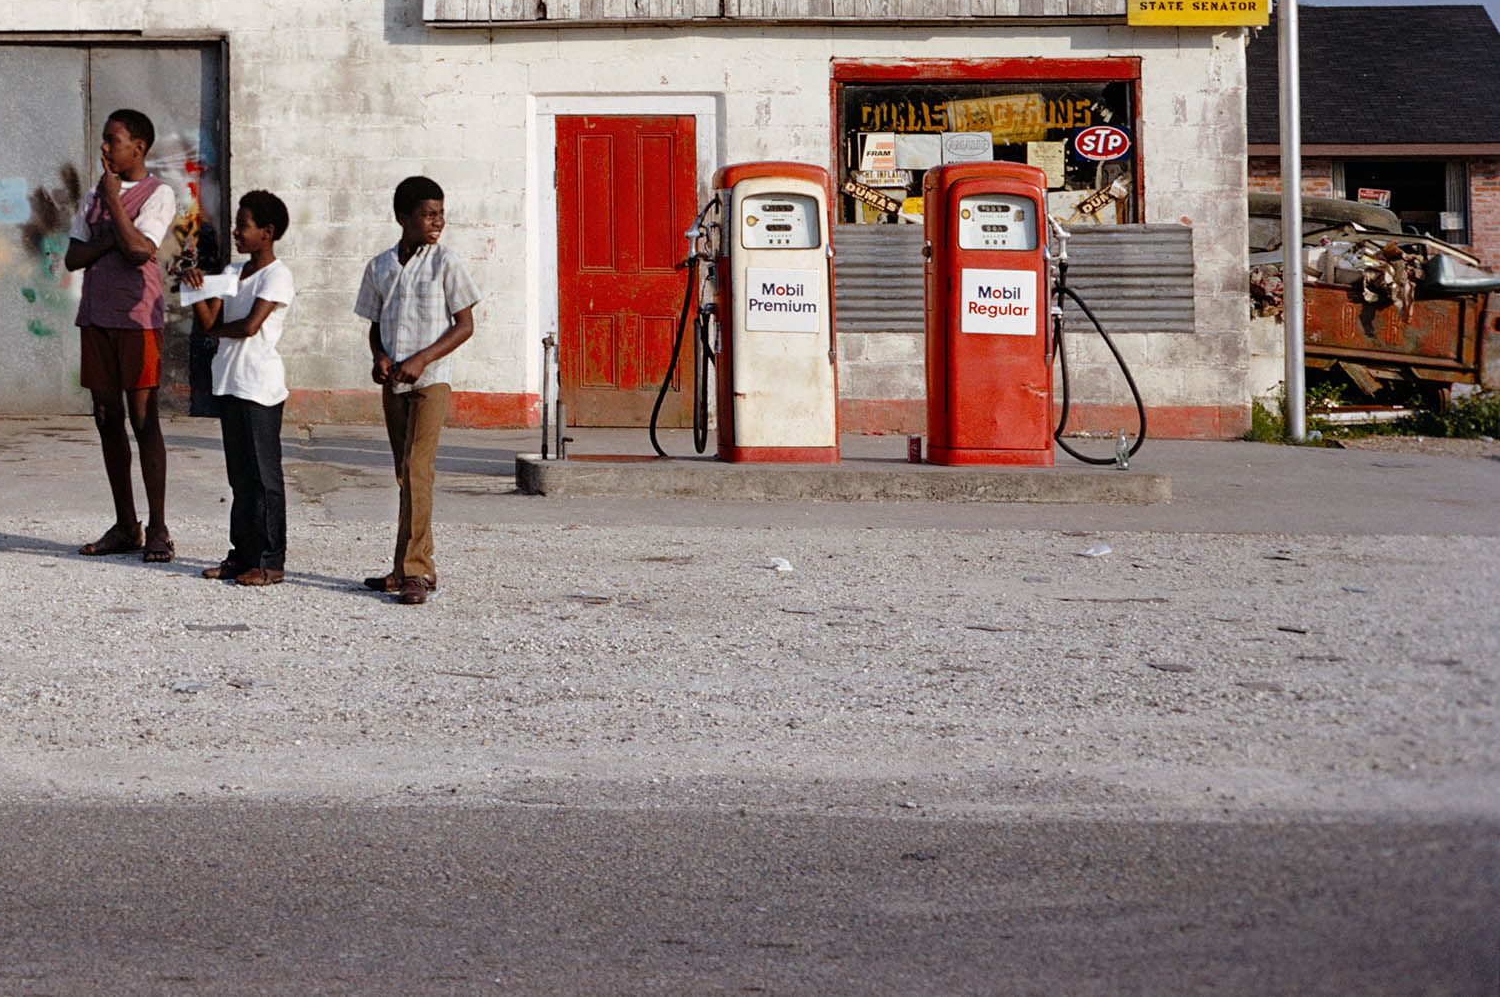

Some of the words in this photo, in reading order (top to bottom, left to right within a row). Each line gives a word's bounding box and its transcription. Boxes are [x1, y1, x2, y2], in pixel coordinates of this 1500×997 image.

[1140, 1, 1184, 11] STATE
[1192, 1, 1257, 11] SENATOR
[1082, 129, 1122, 154] STP
[845, 182, 898, 212] DUMAS
[1082, 192, 1111, 214] DUM
[761, 283, 804, 297] Mobil
[978, 286, 1021, 300] Mobil
[749, 299, 817, 313] Premium
[968, 301, 1029, 318] Regular
